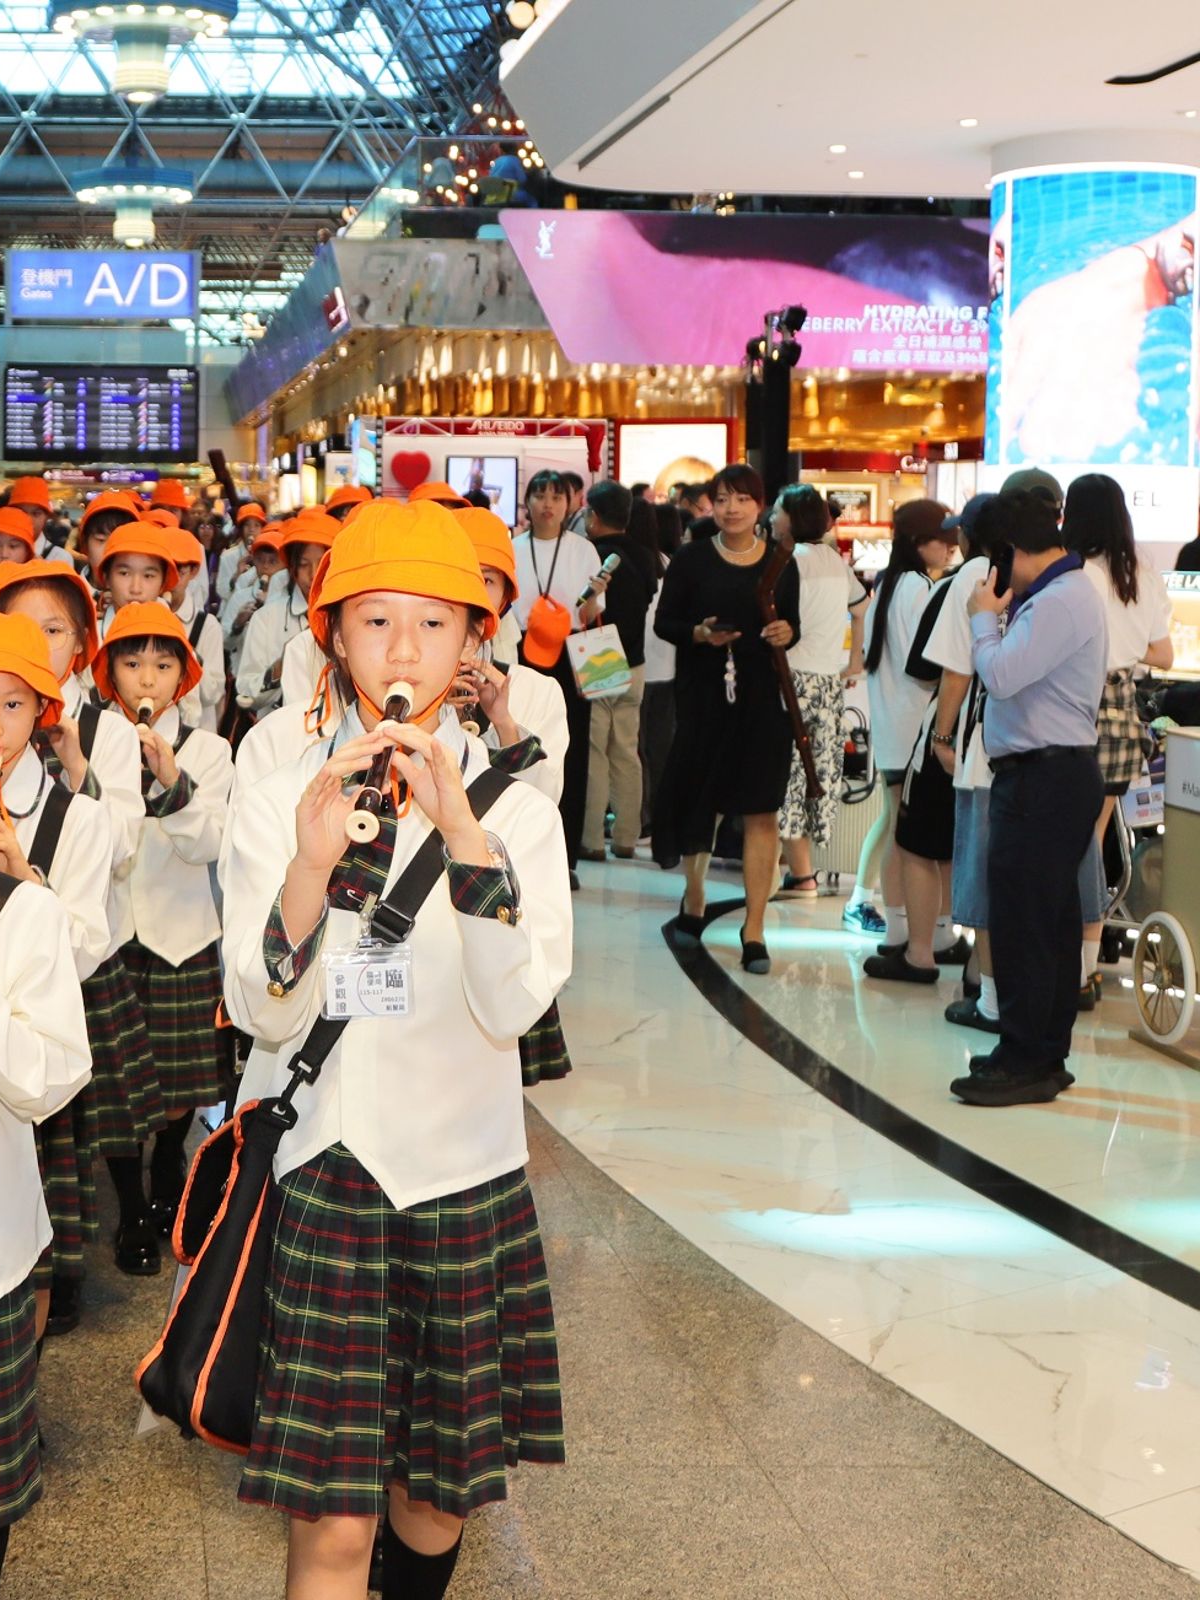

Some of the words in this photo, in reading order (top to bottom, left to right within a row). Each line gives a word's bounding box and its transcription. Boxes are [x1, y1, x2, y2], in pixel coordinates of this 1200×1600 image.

[20, 268, 74, 287] 登機門
[84, 262, 188, 307] A/D
[20, 288, 53, 300] Gates
[863, 304, 973, 320] HYDRATING
[802, 317, 865, 332] EBERRY
[870, 318, 944, 333] EXTRACT
[466, 419, 525, 431] SHISEIDO
